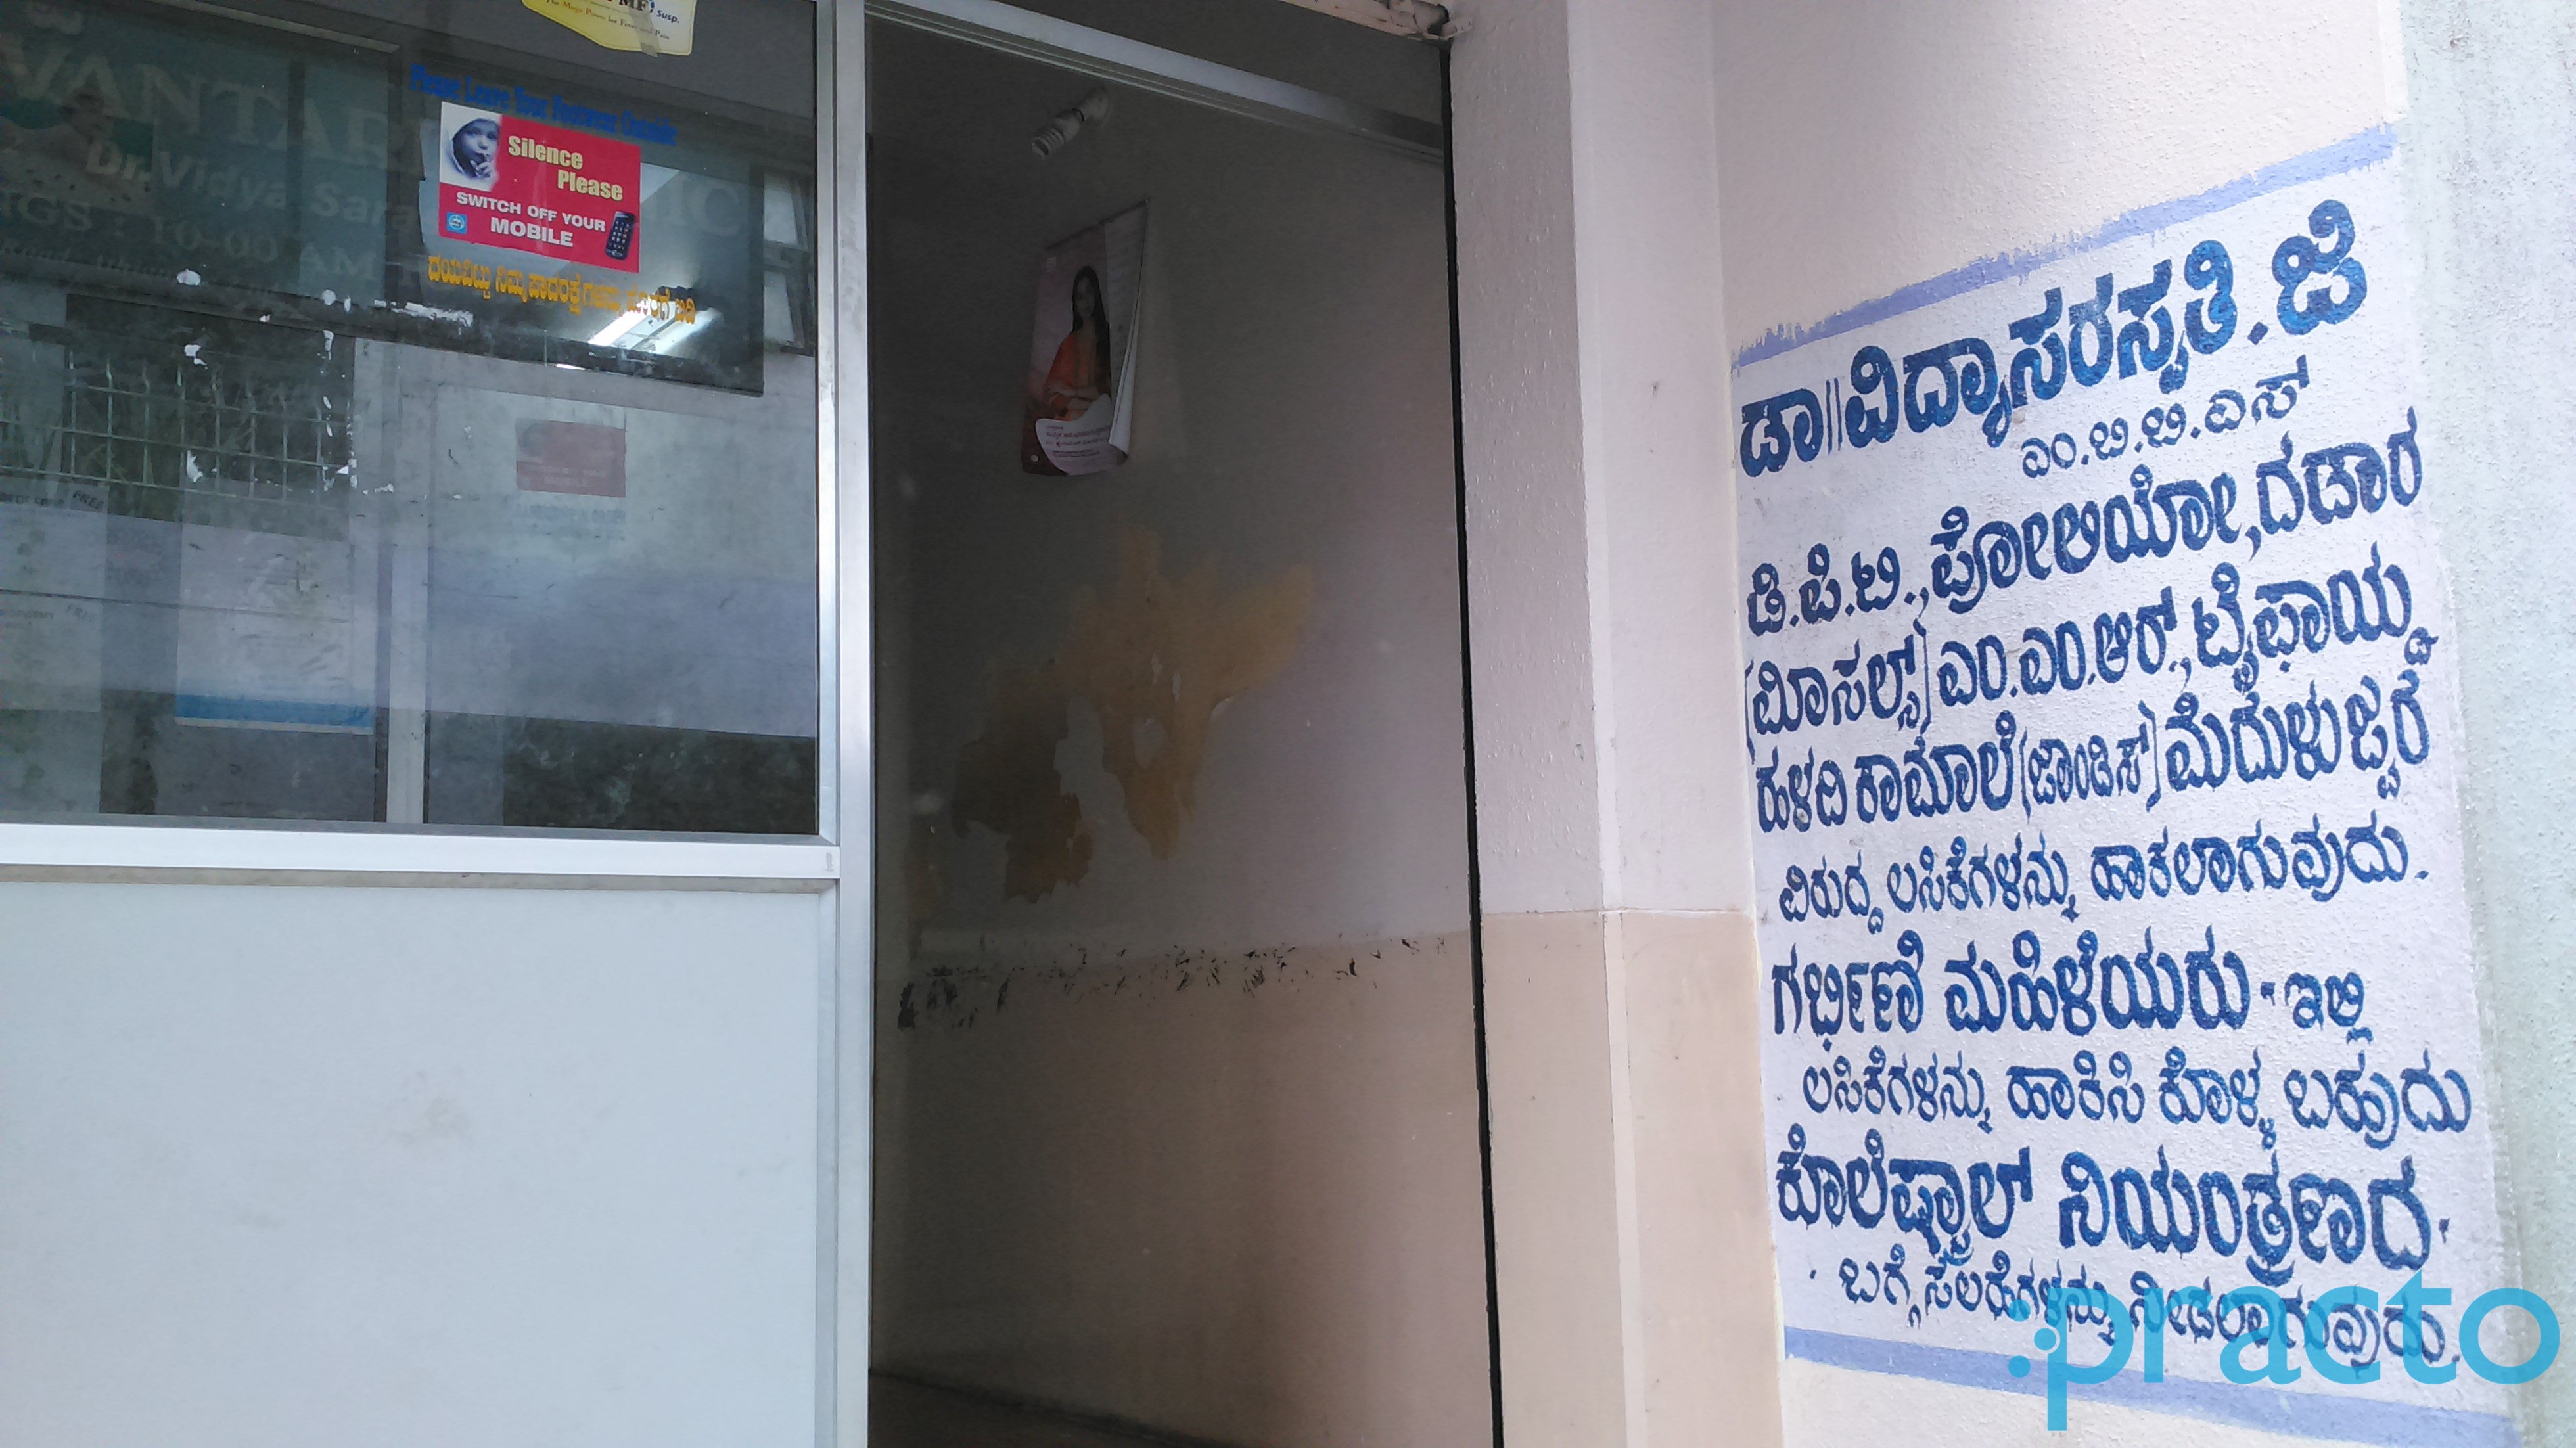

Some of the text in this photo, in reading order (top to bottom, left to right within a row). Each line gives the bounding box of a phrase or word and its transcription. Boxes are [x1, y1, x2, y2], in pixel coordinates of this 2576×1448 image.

[656, 10, 679, 23] Susp.
[410, 64, 678, 146] Please Leave Your Footwear Outside
[509, 135, 583, 170] Silence
[557, 169, 623, 201] Please
[456, 192, 606, 232] SWITCH OFF YOUR
[490, 216, 573, 247] MOBILE
[1756, 745, 1847, 833] ಹಳದಿ
